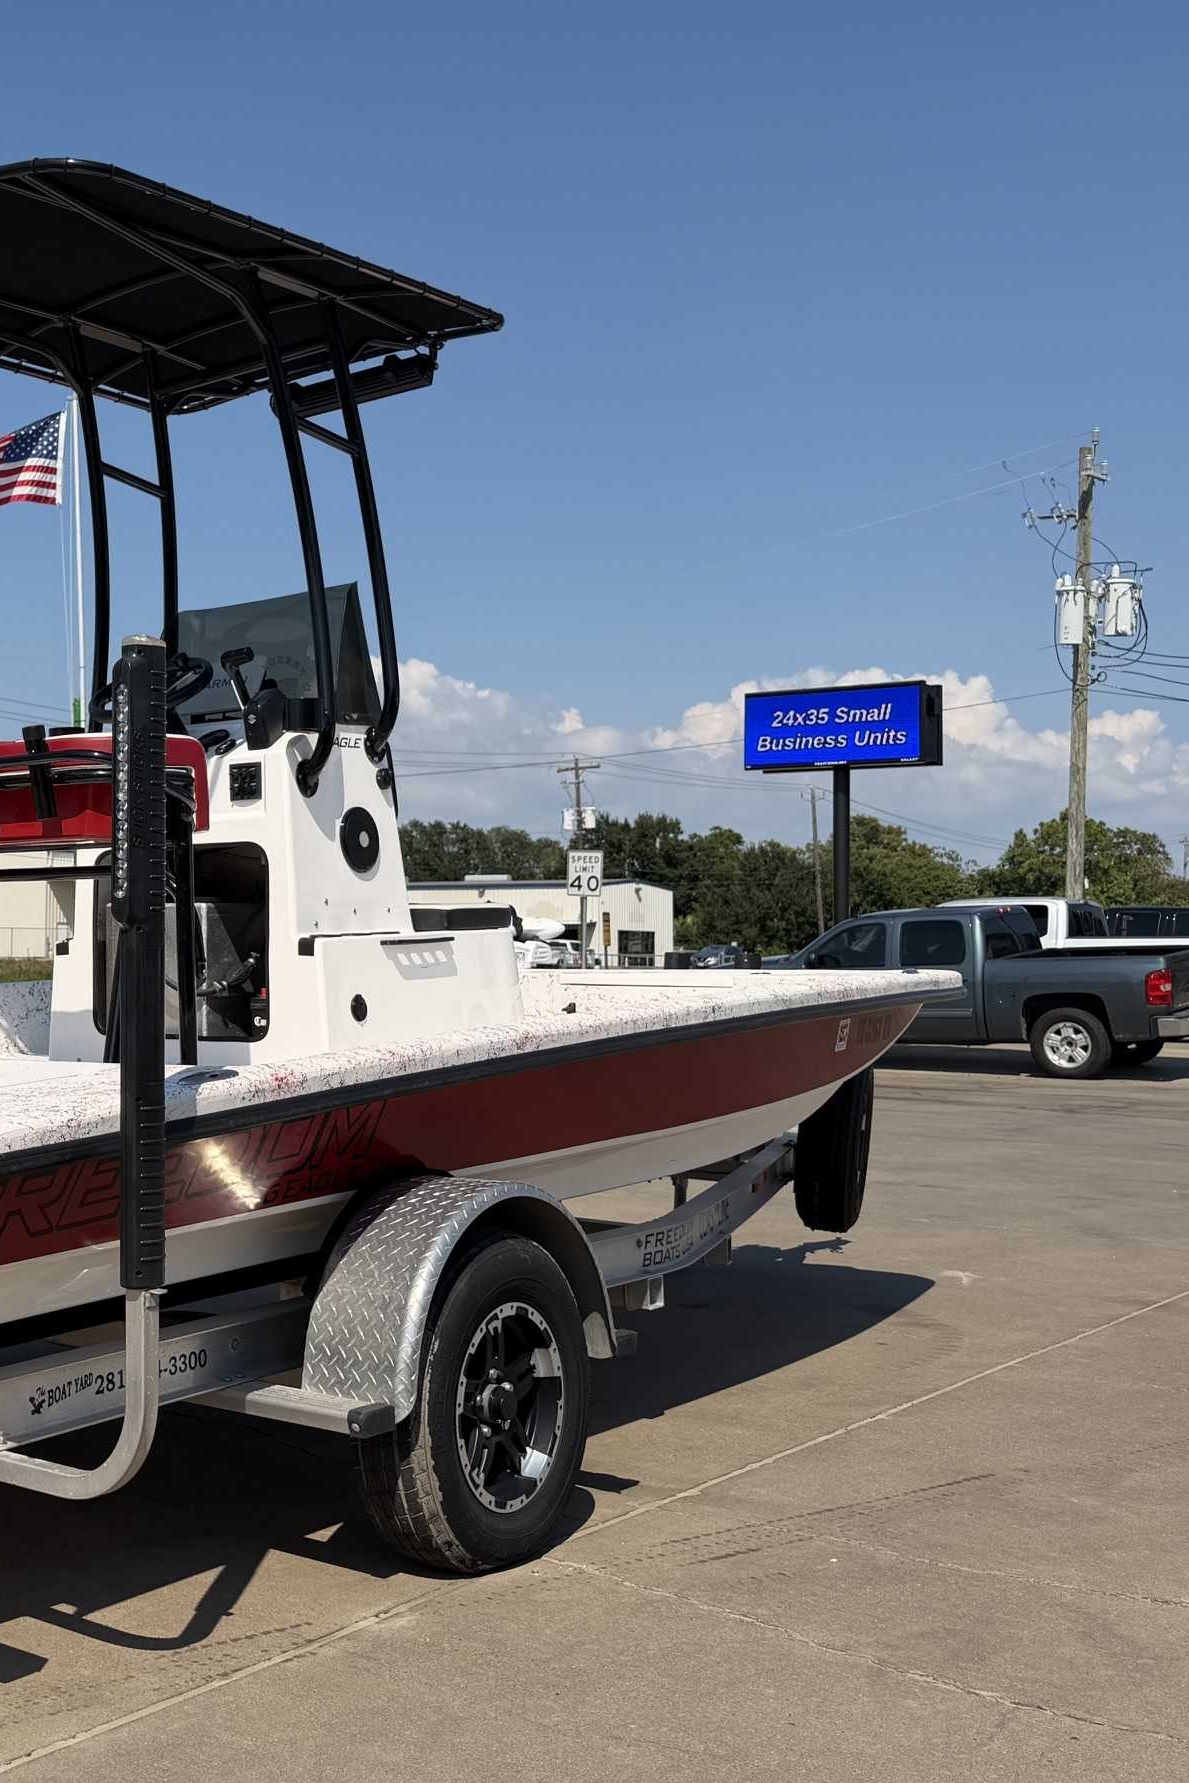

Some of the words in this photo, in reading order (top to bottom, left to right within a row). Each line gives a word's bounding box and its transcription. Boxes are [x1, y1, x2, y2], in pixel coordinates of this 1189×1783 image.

[771, 707, 829, 728] 24x35
[834, 702, 893, 724] Small
[331, 736, 362, 749] AGLE
[757, 732, 848, 752] Business
[854, 728, 908, 747] Units
[570, 855, 600, 864] SPEED
[574, 865, 595, 874] LIMIT
[569, 874, 600, 892] 40
[47, 1381, 73, 1409] BOAT
[74, 1372, 94, 1394] YARD
